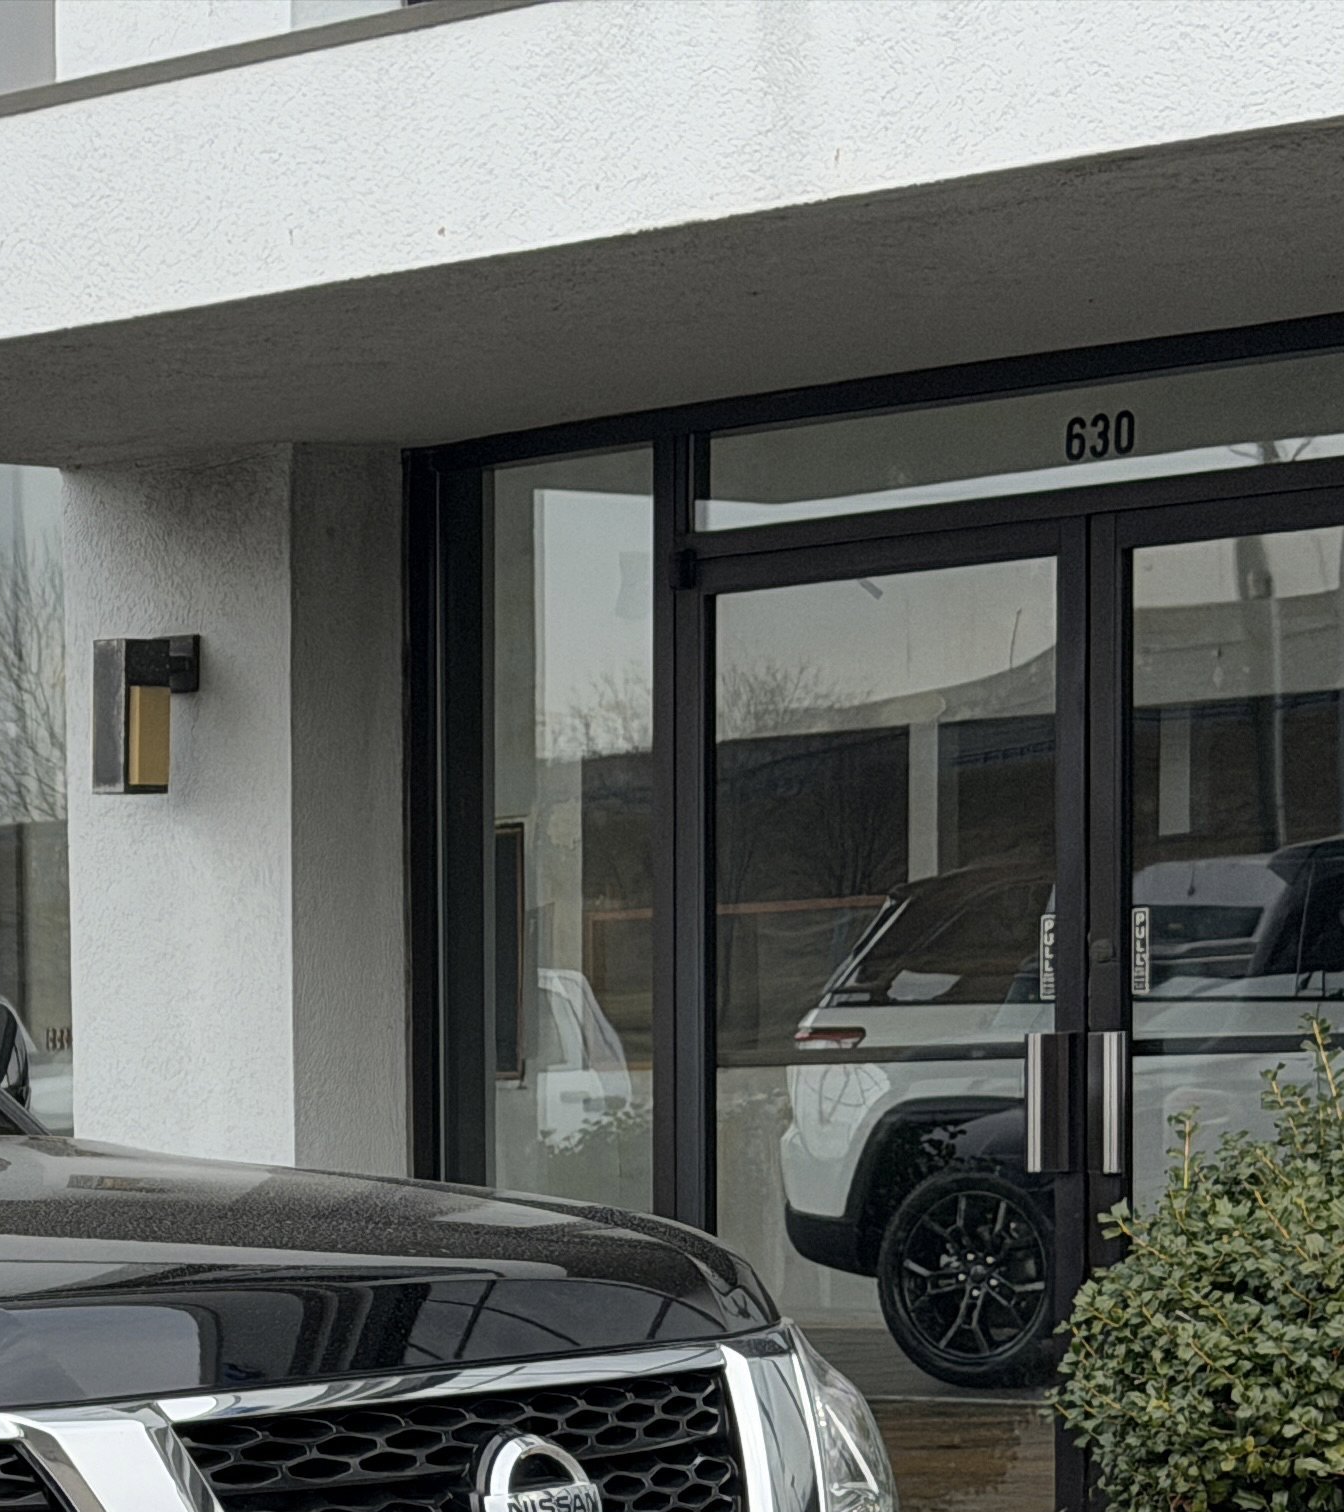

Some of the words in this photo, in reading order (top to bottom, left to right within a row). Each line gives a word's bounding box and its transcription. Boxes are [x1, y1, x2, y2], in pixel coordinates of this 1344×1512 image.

[1066, 410, 1135, 461] 630
[1043, 919, 1055, 972] PULL
[1135, 912, 1145, 966] PULL
